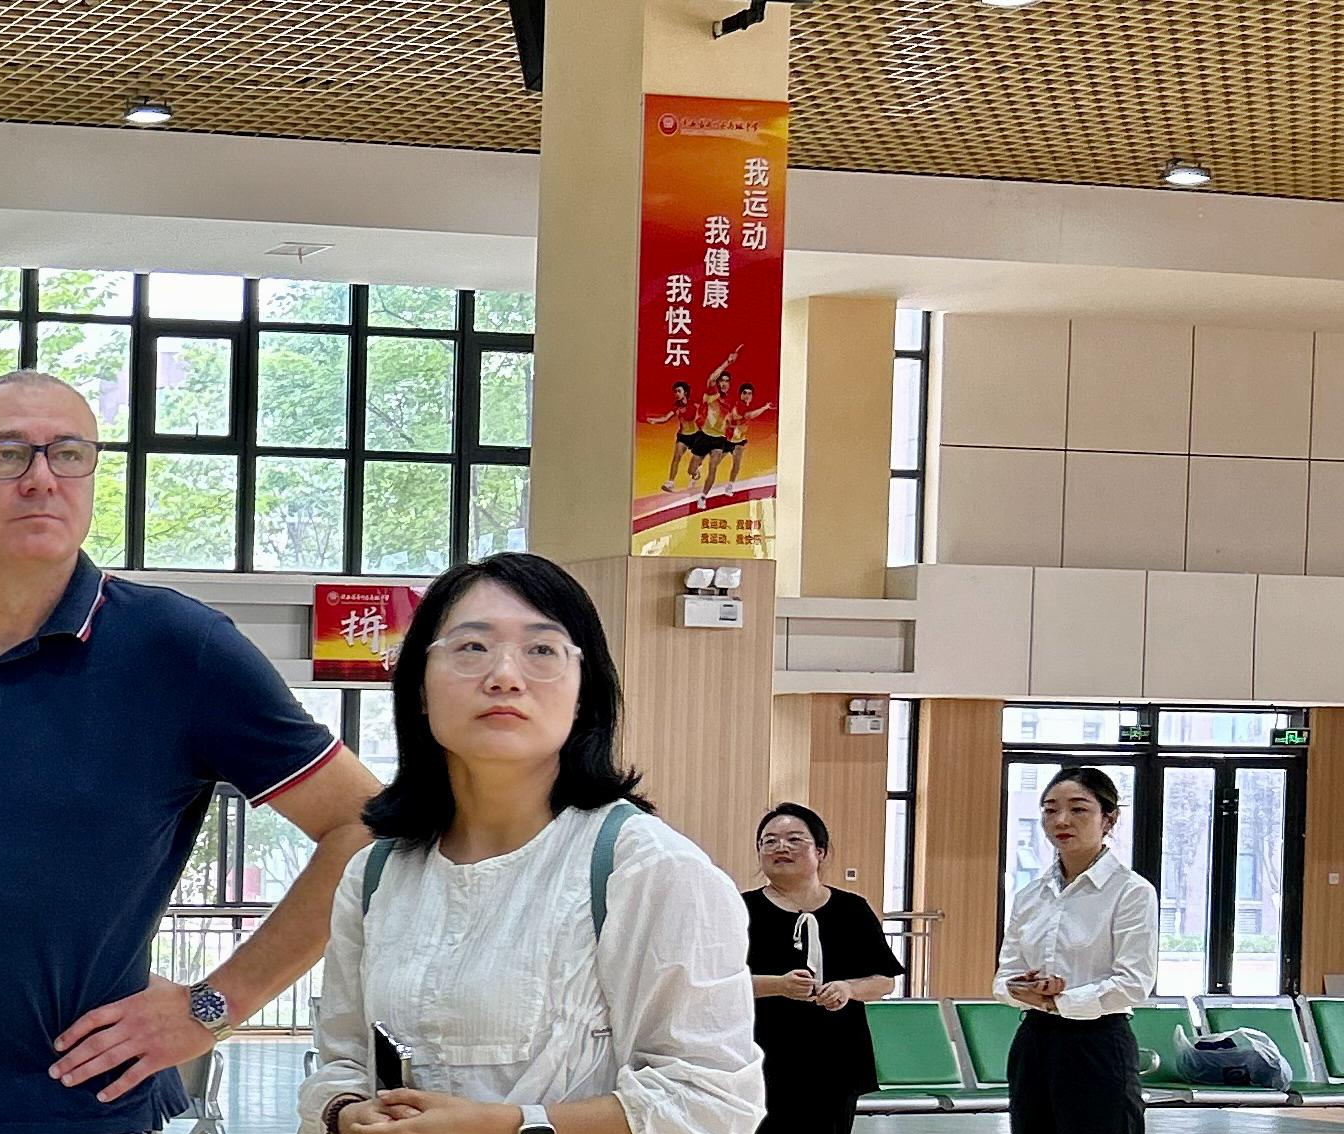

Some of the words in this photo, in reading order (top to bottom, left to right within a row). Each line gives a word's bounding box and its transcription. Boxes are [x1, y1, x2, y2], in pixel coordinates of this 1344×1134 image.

[742, 157, 769, 250] 我运动
[703, 215, 730, 309] 我健康
[664, 274, 692, 366] 我快乐
